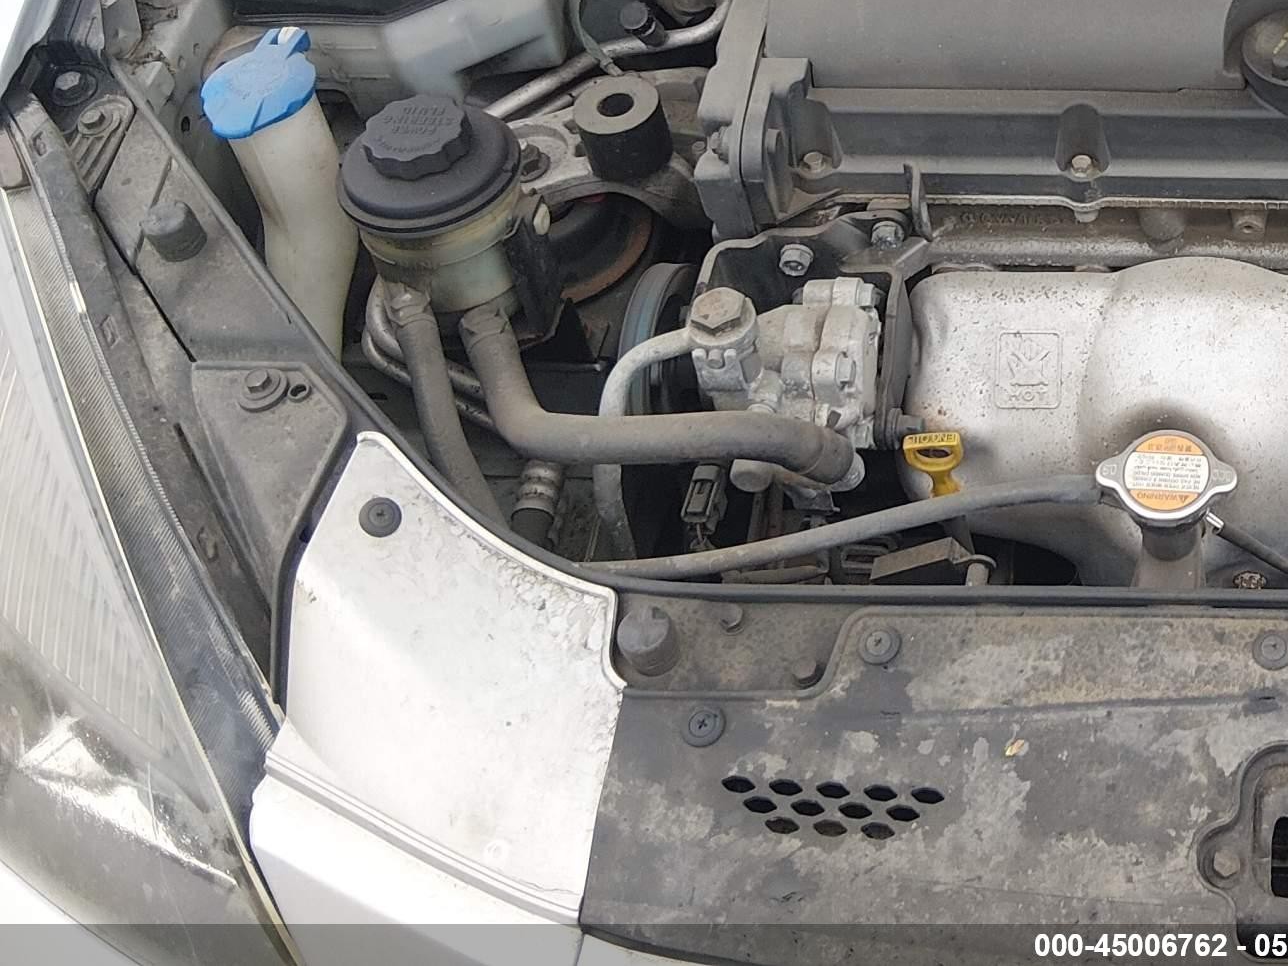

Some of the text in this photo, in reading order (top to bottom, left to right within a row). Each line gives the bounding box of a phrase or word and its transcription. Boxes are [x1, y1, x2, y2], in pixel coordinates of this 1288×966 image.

[403, 106, 446, 116] FLUID
[383, 115, 455, 126] STEERING
[906, 433, 956, 444] ENG OIL
[1136, 492, 1177, 502] WARNING
